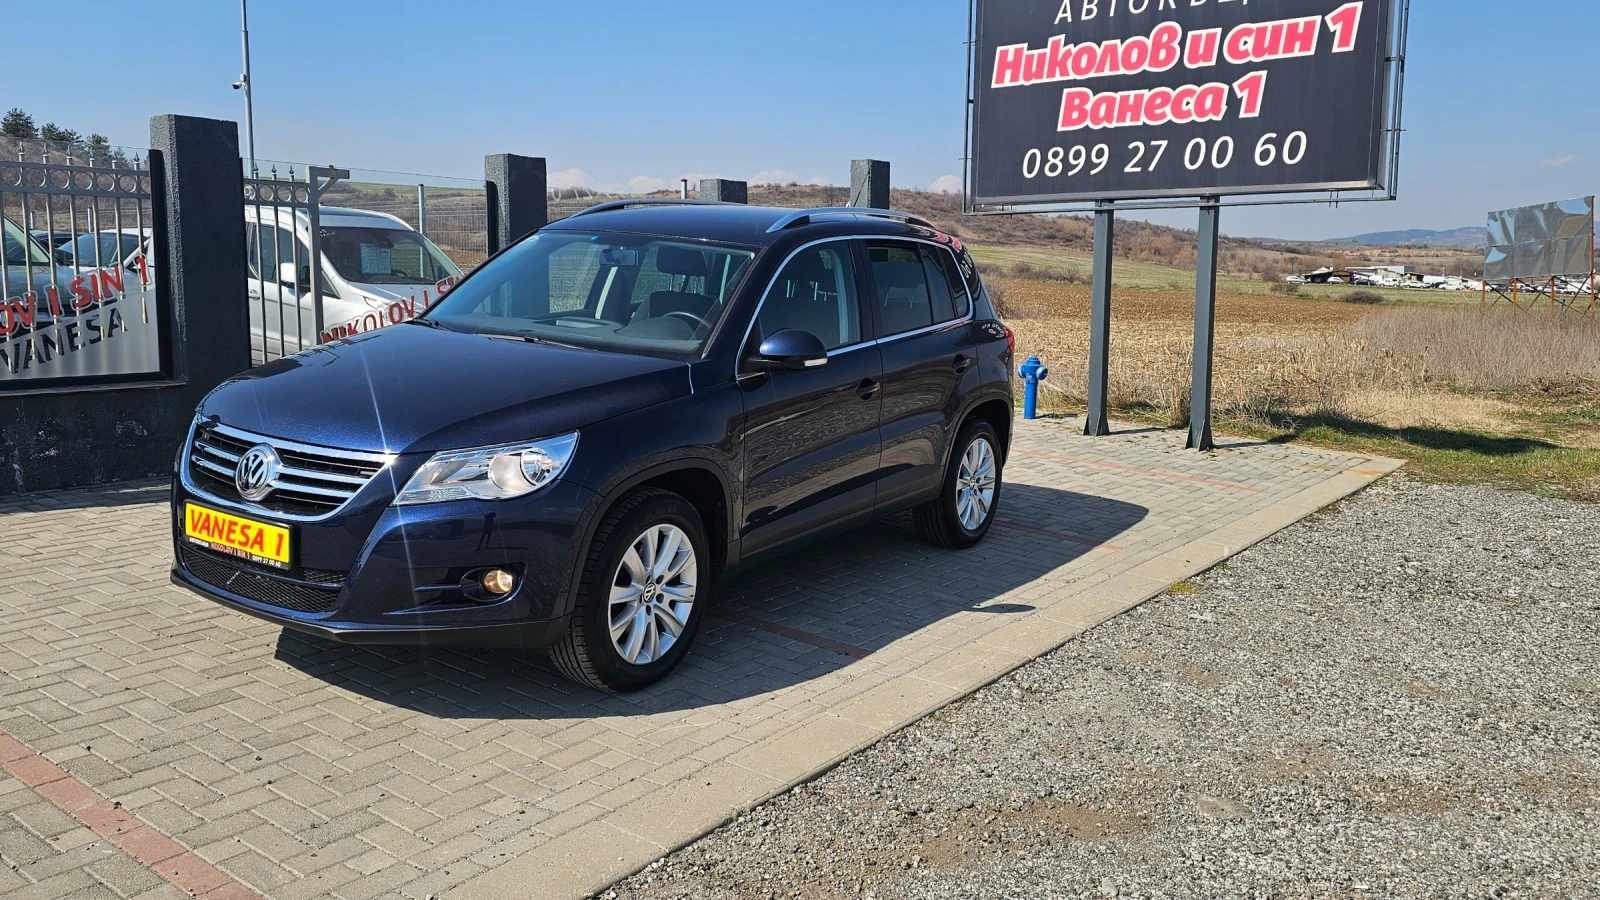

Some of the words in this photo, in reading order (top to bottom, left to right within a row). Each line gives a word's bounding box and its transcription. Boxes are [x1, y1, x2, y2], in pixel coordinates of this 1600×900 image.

[992, 21, 1181, 88] Николов
[1184, 28, 1222, 68] и
[1222, 15, 1322, 64] син
[1326, 1, 1363, 52] 1
[1057, 82, 1228, 131] Ванеса
[1233, 71, 1267, 117] 1
[1022, 143, 1110, 178] 0899
[1123, 140, 1168, 173] 27
[1183, 135, 1234, 170] 00
[1254, 131, 1307, 166] 60
[70, 263, 125, 308] SIN
[134, 256, 150, 285] 1
[0, 306, 128, 374] VANESA
[190, 508, 264, 552] VANESA
[275, 532, 284, 557] 1
